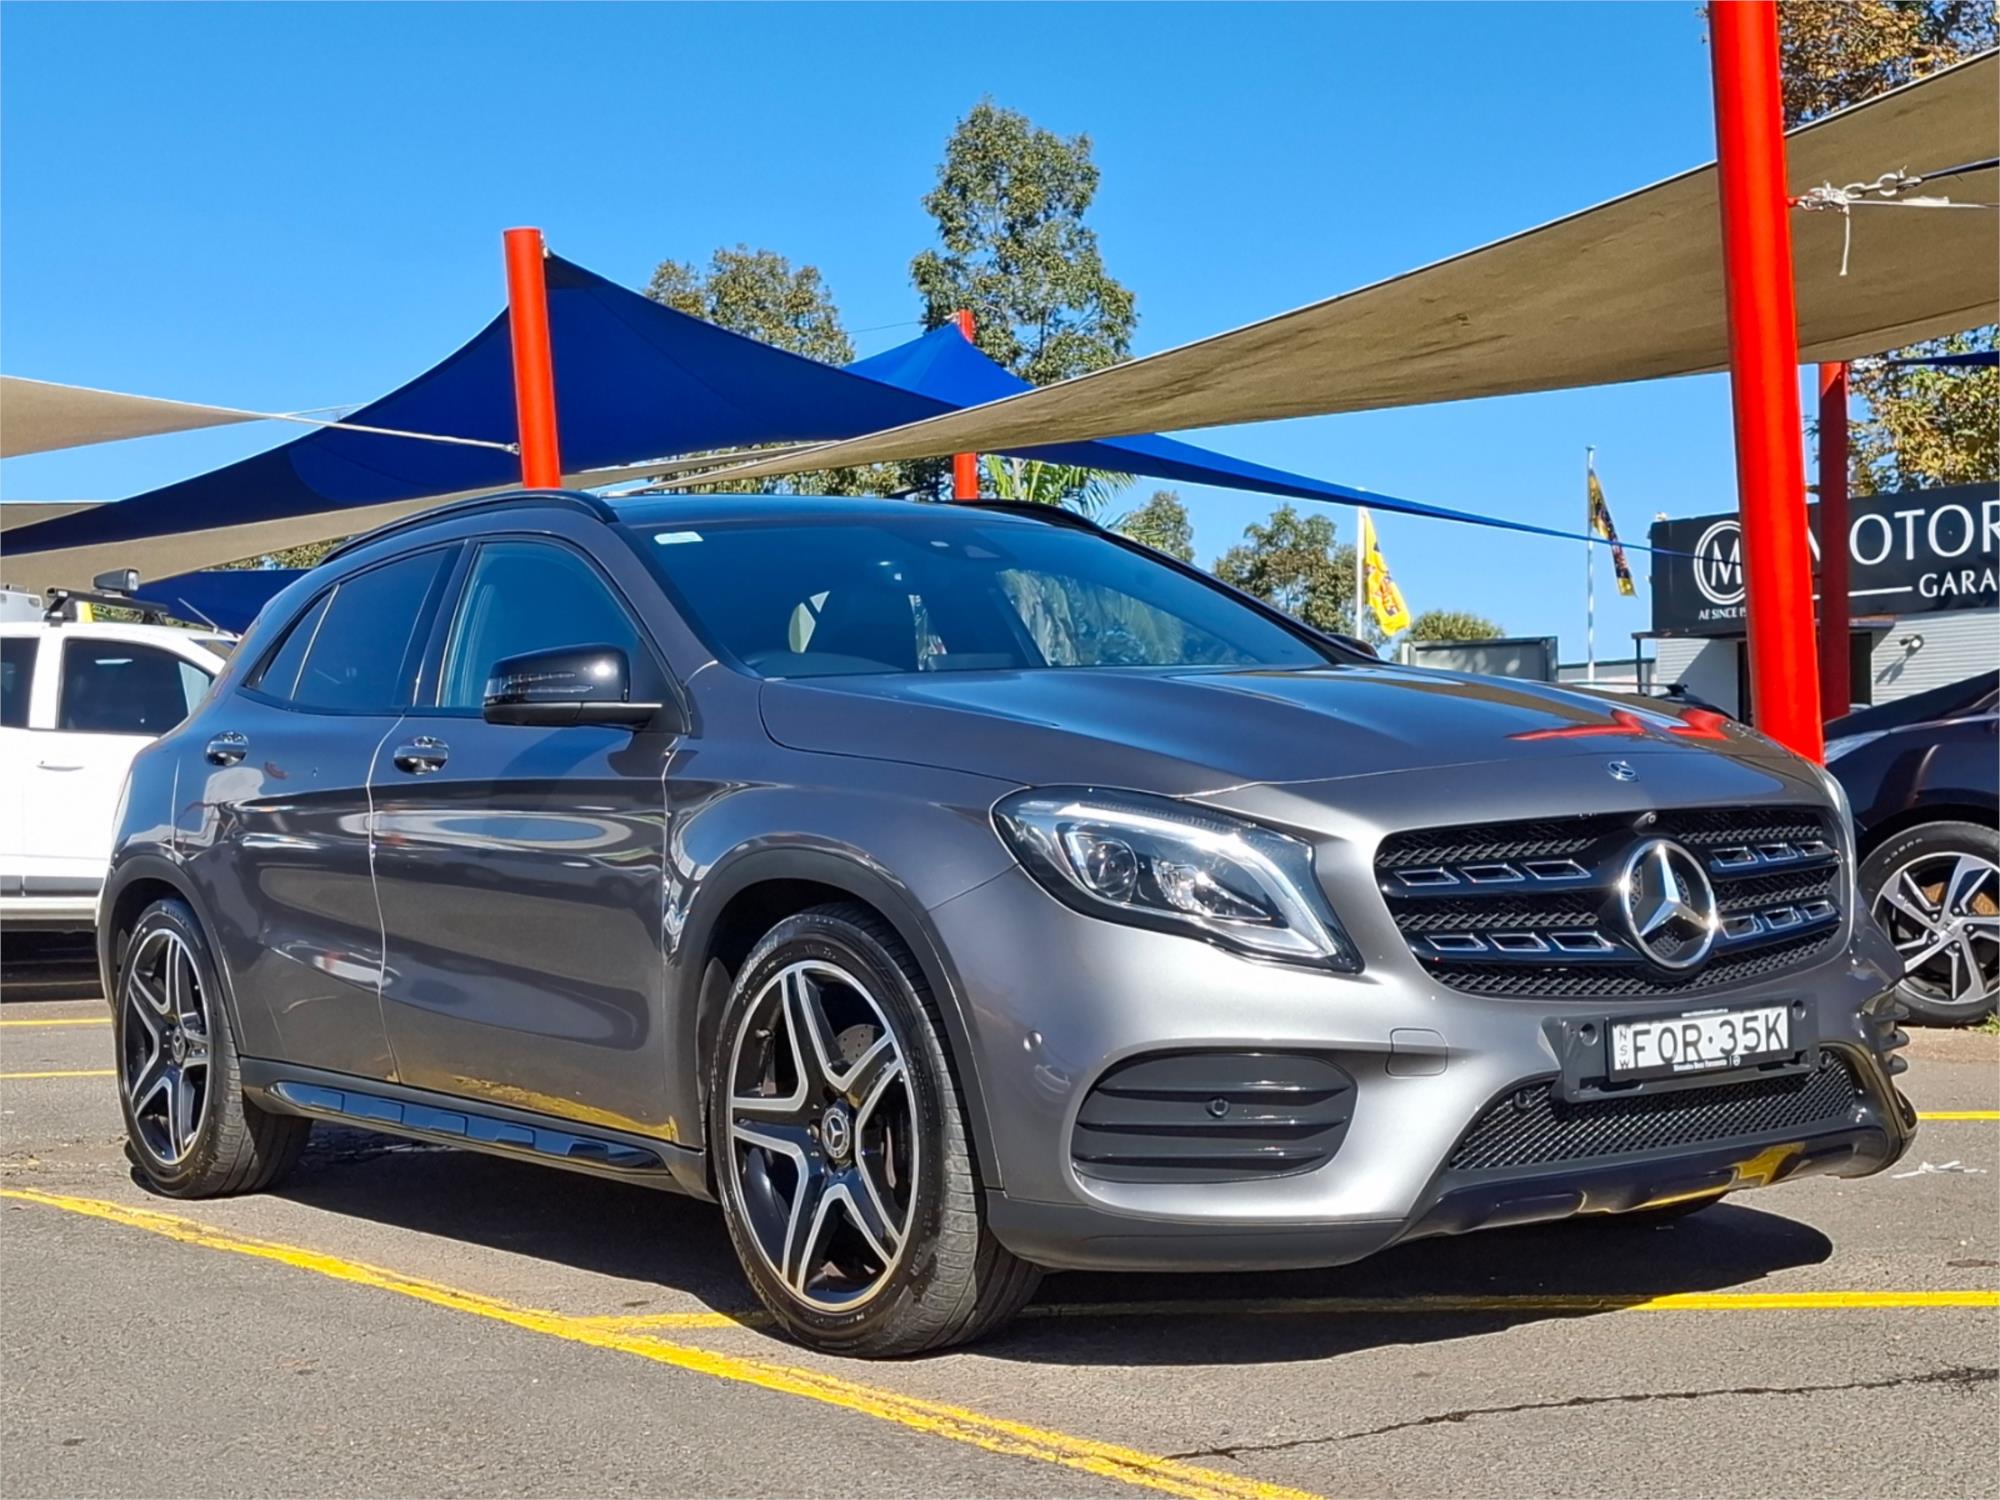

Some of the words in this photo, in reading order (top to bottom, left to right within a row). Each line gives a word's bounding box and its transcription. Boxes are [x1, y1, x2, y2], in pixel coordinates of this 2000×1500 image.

[1808, 500, 1999, 565] OTOR
[1710, 537, 1742, 587] M
[1918, 567, 1998, 598] GARA
[1711, 606, 1737, 619] SINCE
